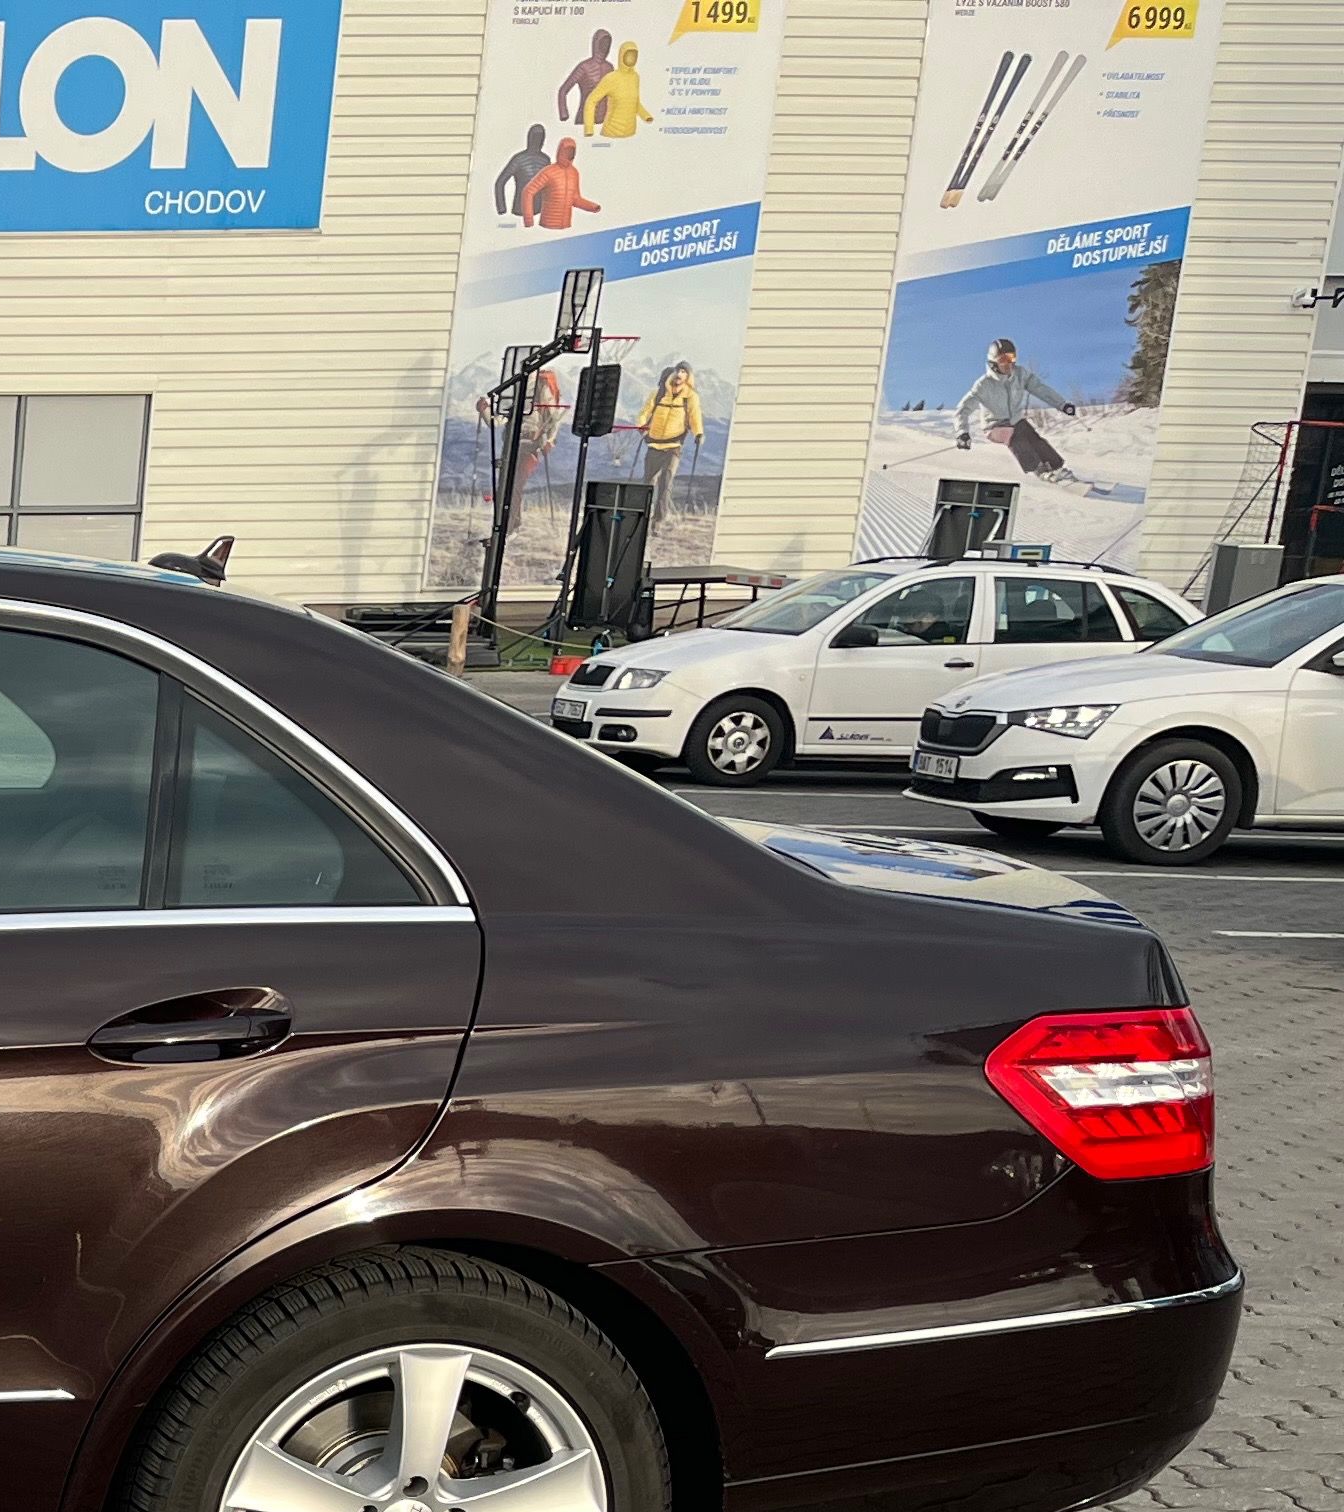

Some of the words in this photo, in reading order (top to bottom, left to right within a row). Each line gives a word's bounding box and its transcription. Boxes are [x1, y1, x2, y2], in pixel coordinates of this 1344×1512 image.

[513, 6, 520, 15] S
[521, 4, 553, 15] KAPUCÍ
[554, 6, 568, 15] MT
[569, 6, 585, 15] 100
[144, 189, 266, 215] CHODOV
[614, 228, 670, 254] DĚLÁME
[672, 218, 721, 242] SPORT
[640, 231, 740, 267] DOSTUPNĚJŠÍ
[1047, 230, 1102, 255] DĚLÁME
[1105, 222, 1152, 245] SPORT
[1072, 235, 1169, 269] DOSTUPNĚJŠÍ
